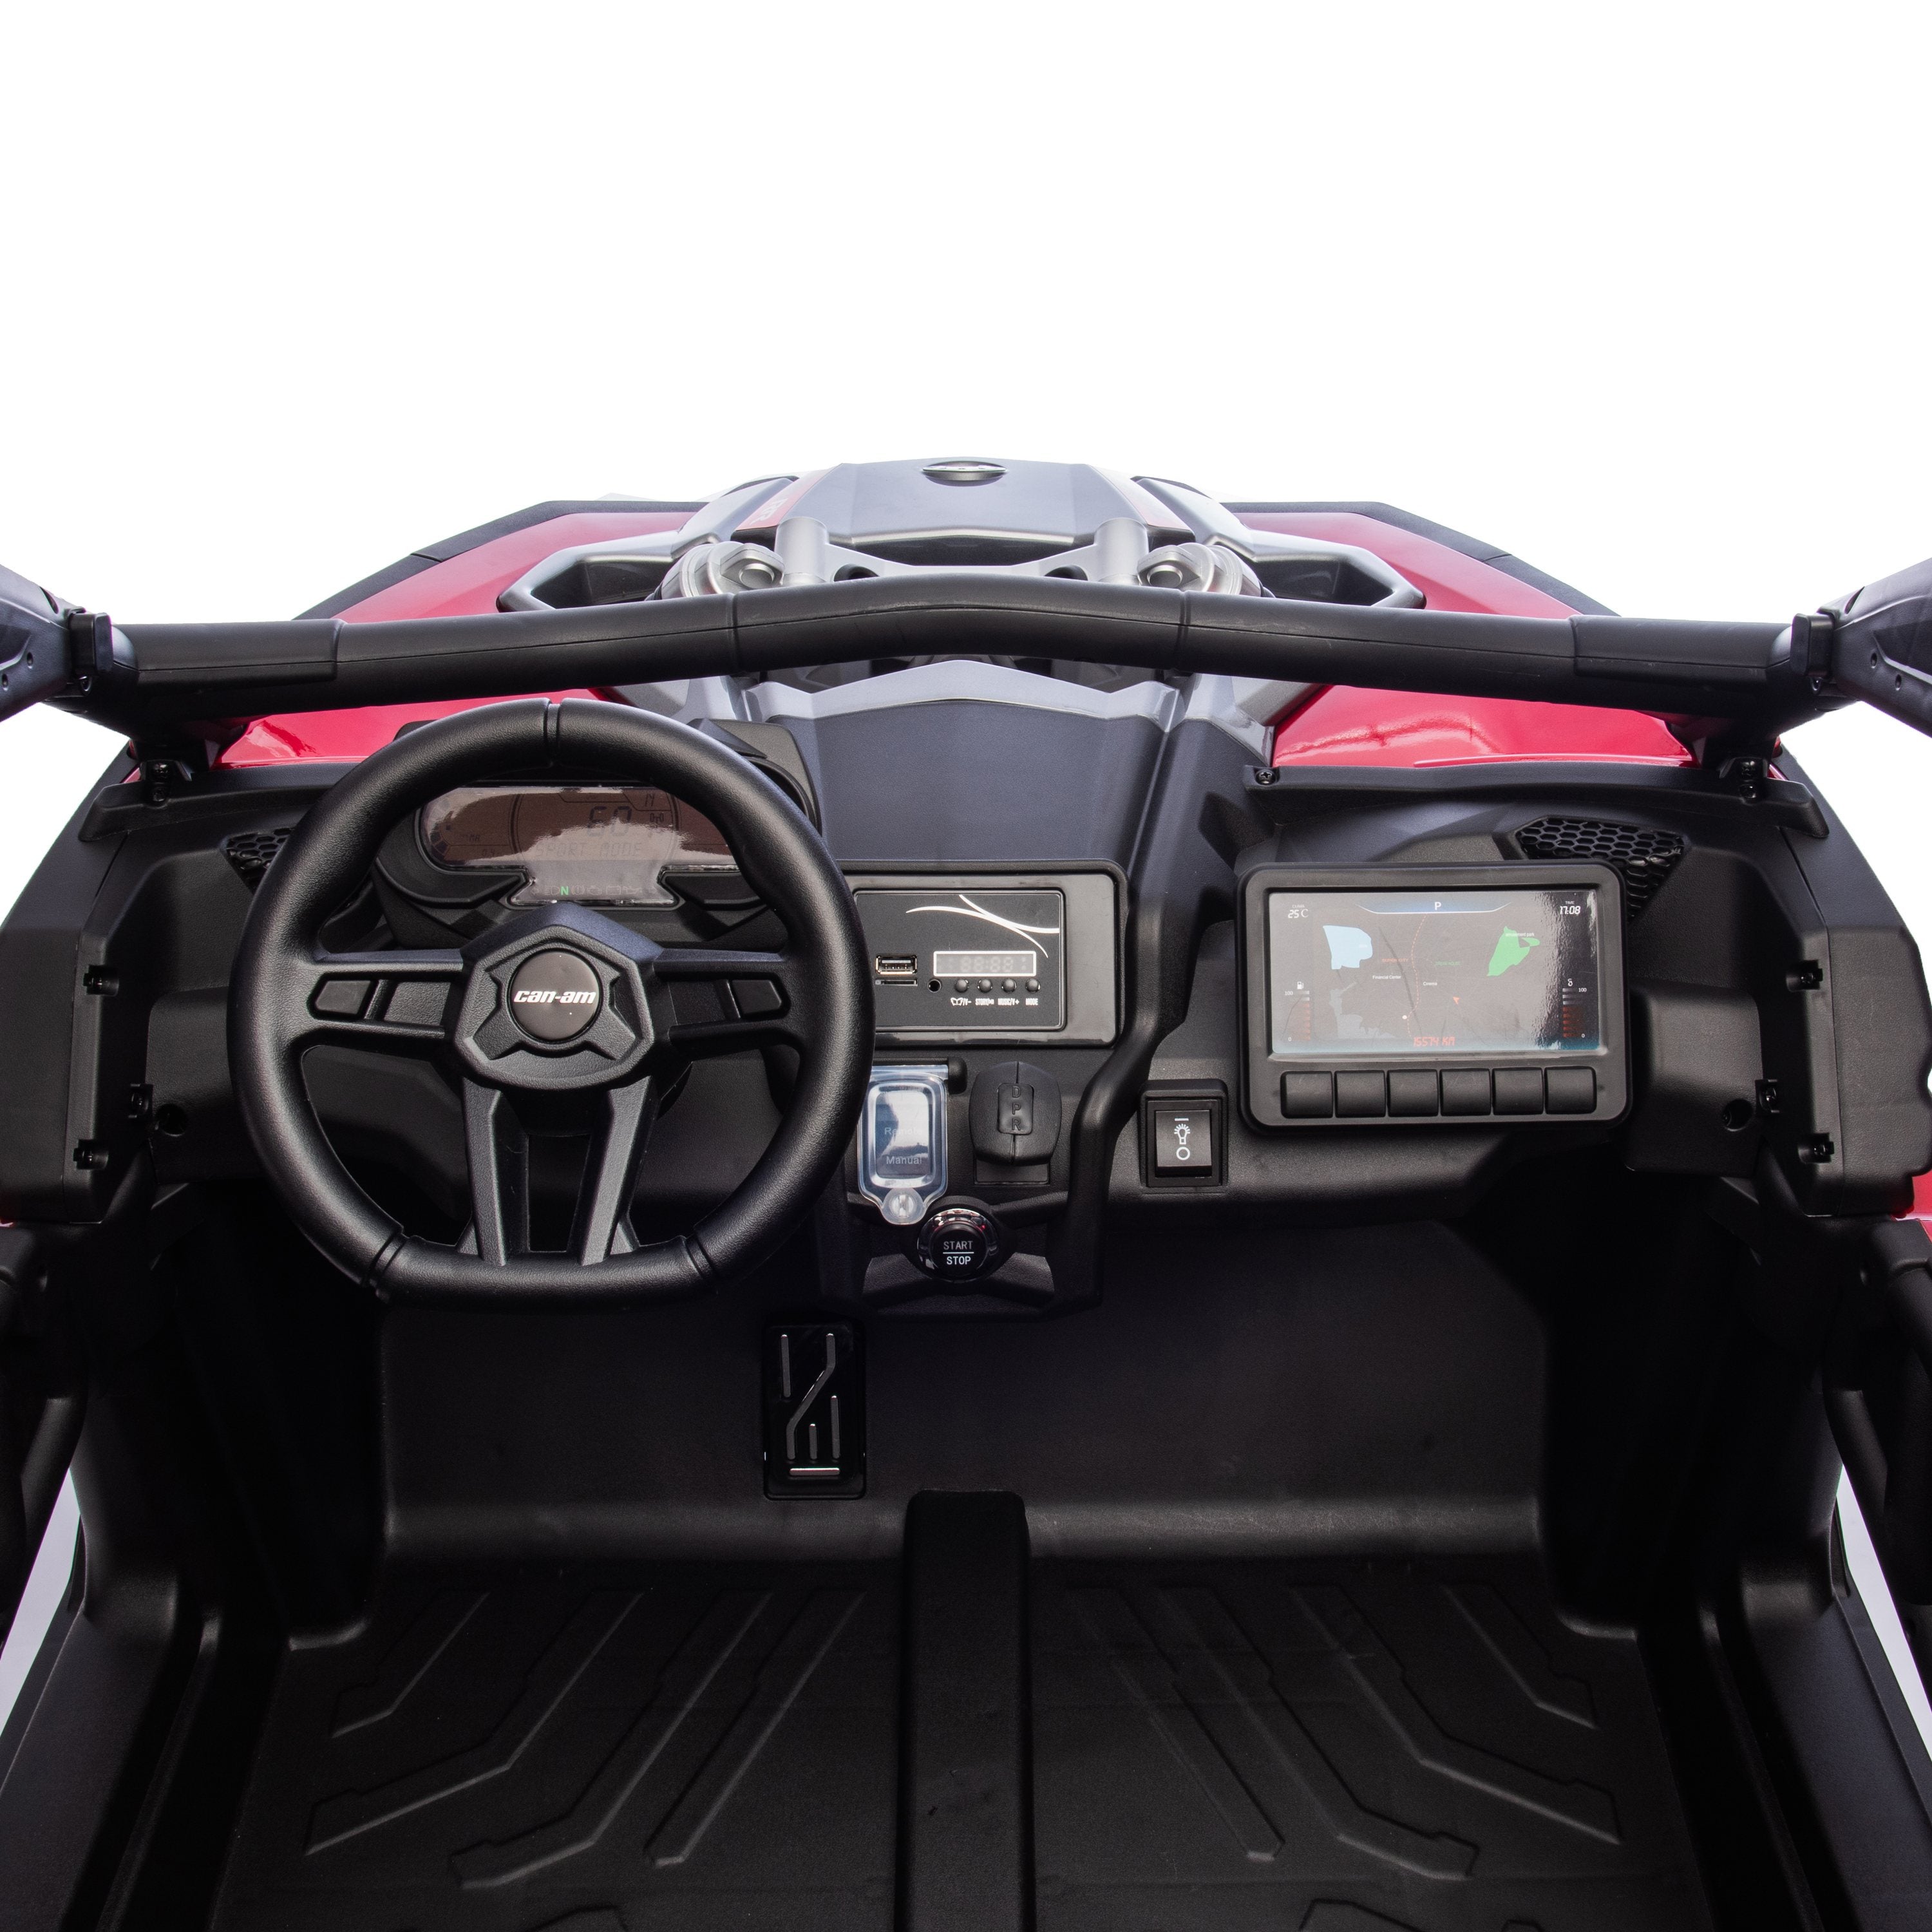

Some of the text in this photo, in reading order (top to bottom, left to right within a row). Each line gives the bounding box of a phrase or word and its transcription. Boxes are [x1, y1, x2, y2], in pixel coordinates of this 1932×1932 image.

[560, 886, 569, 896] N
[1434, 902, 1442, 911] P
[1560, 905, 1581, 914] 17:08
[513, 990, 597, 1005] can-am
[1025, 998, 1039, 1006] MODE
[1011, 1085, 1021, 1099] D
[1012, 1101, 1021, 1115] P
[1011, 1117, 1021, 1132] R
[886, 1156, 922, 1165] Manual
[943, 1240, 974, 1251] START
[946, 1255, 971, 1266] STOP
